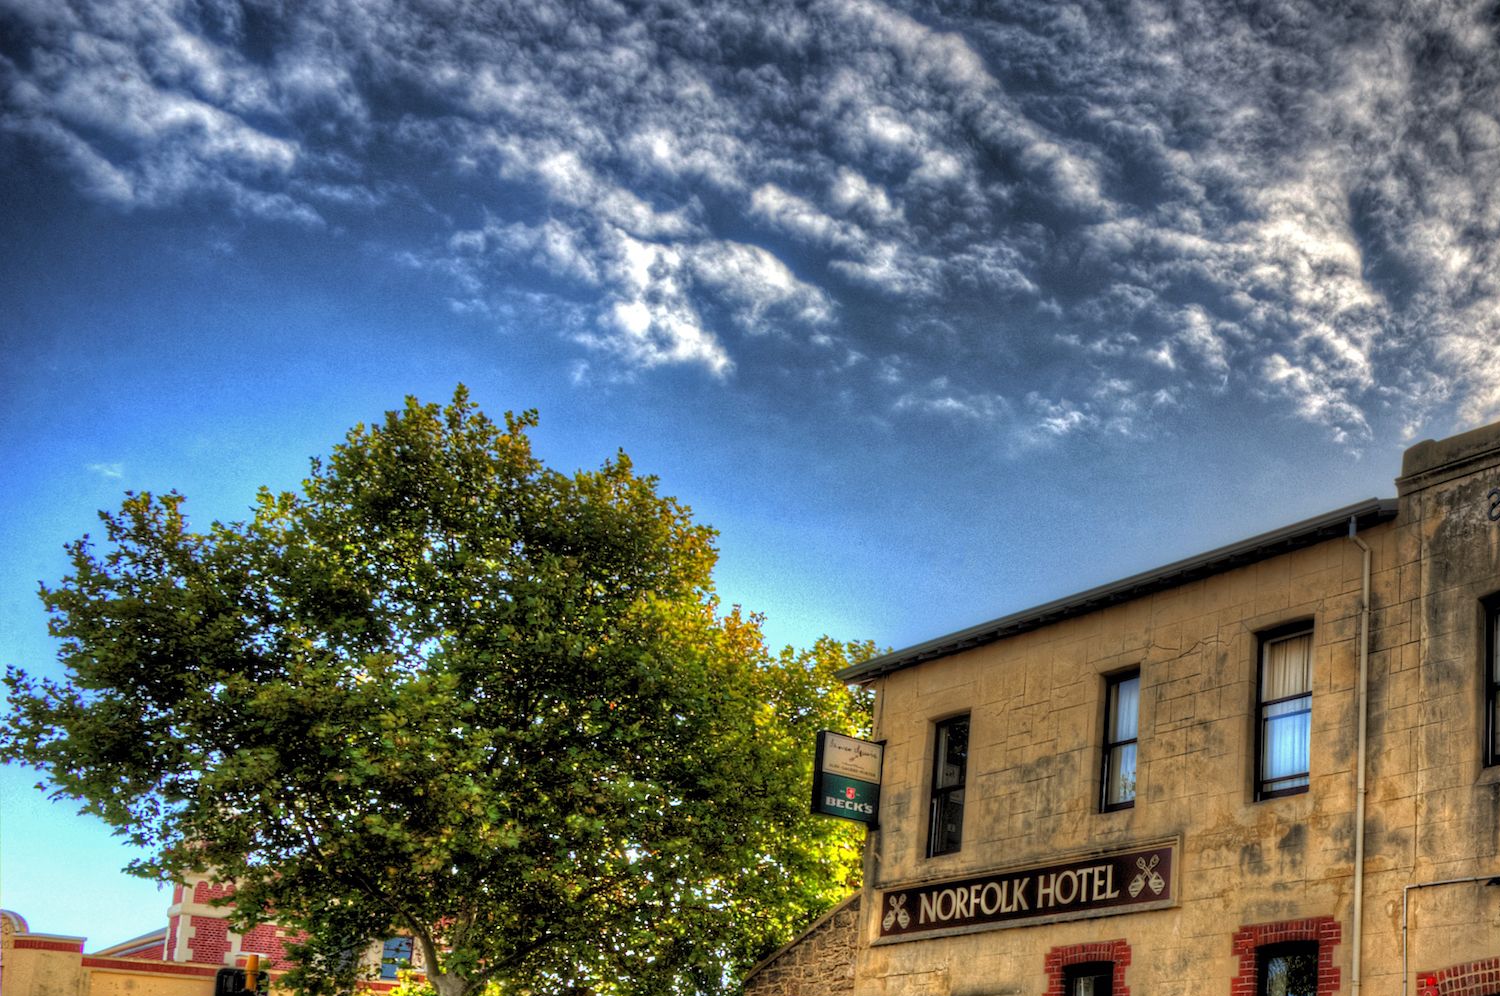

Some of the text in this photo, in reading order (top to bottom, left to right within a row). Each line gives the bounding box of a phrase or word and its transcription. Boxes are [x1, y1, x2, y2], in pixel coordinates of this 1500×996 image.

[825, 796, 873, 814] BECK'S
[919, 864, 1120, 924] NORFOLK HOTEL
